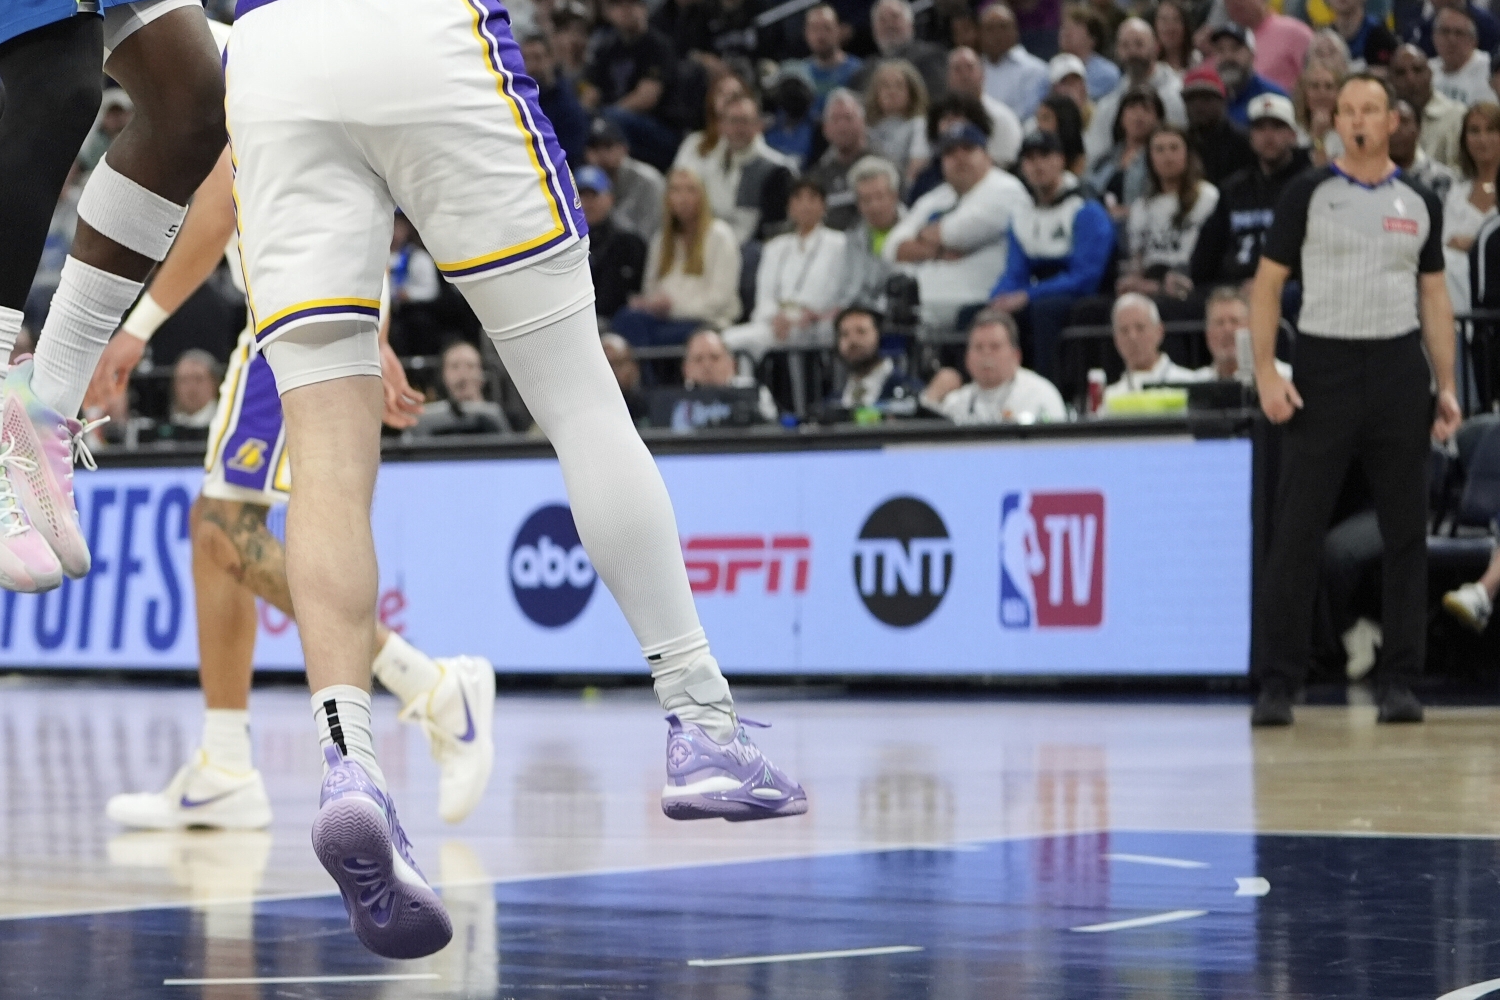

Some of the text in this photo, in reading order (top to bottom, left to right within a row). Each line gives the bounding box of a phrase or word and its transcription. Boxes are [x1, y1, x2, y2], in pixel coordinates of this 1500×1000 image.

[165, 224, 179, 238] 5
[511, 535, 595, 588] abc
[684, 536, 811, 593] SPN
[853, 538, 955, 597] TNT
[1043, 511, 1098, 607] TV
